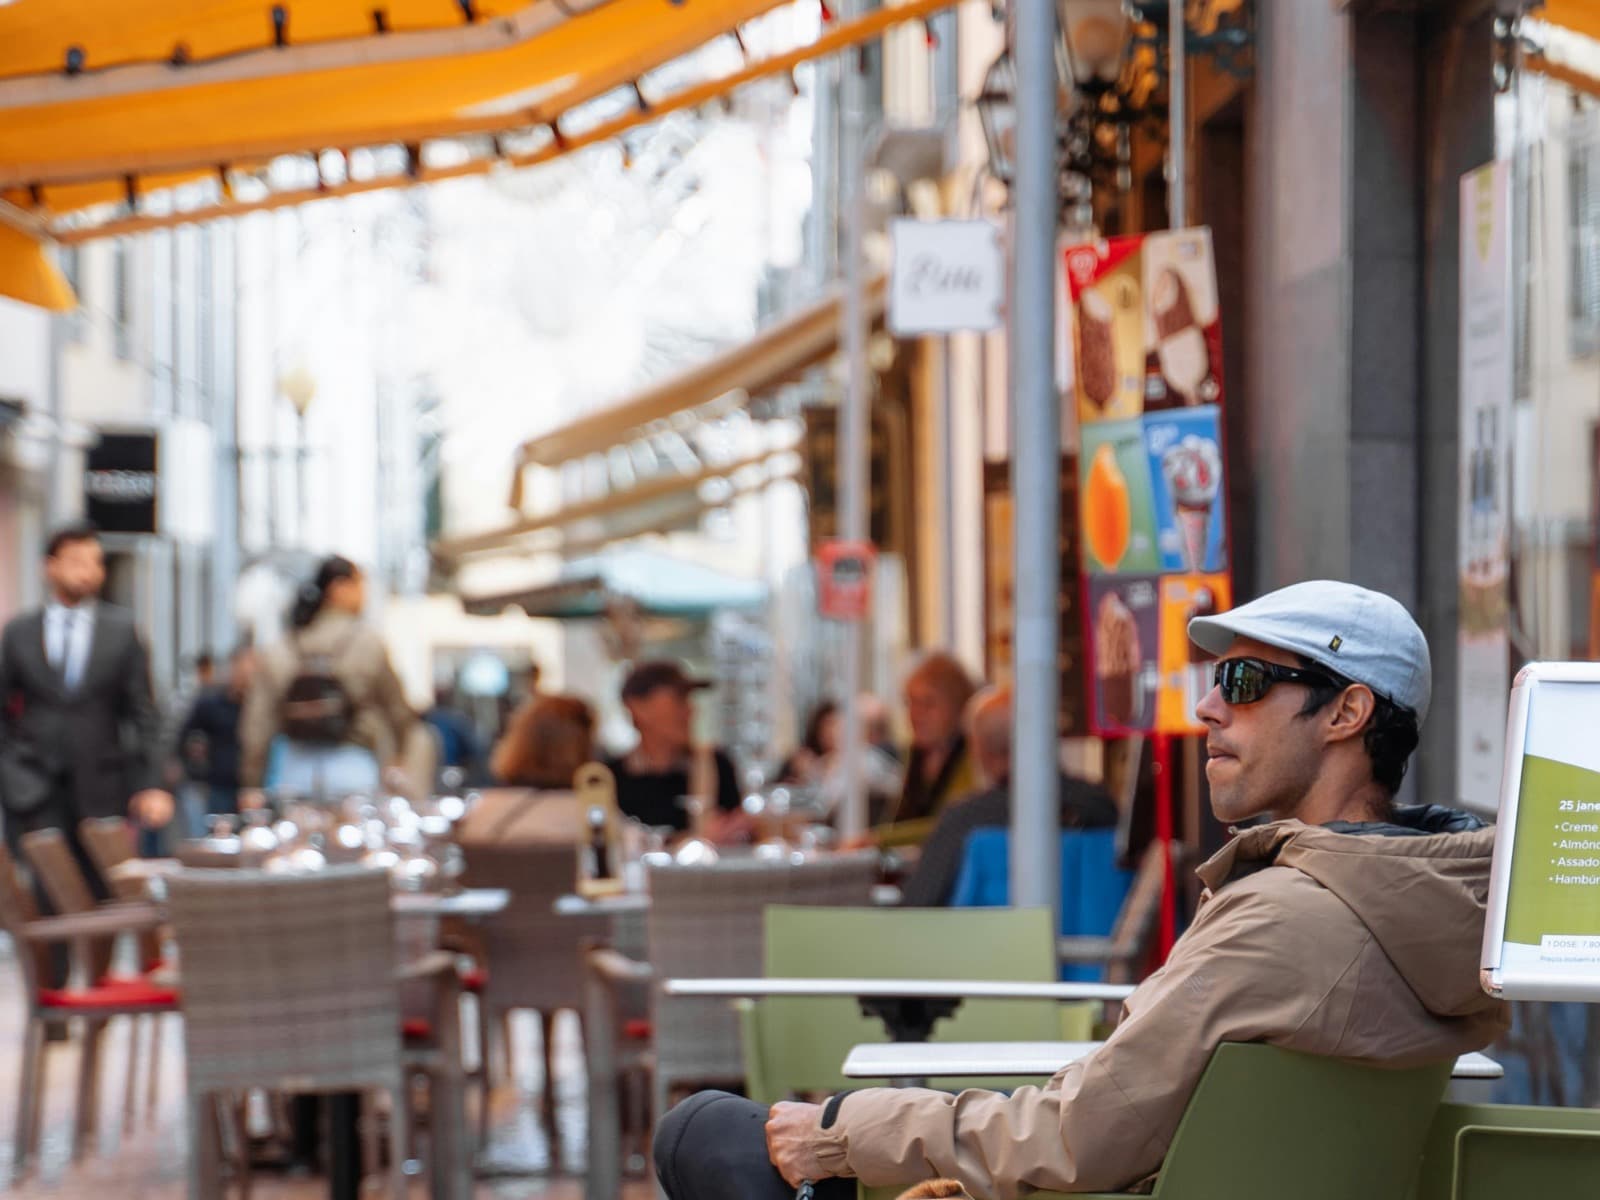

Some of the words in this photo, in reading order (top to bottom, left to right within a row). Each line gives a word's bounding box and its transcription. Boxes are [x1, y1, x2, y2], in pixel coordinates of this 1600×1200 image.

[1559, 799, 1574, 810] 25
[1561, 822, 1599, 832] Creme
[1557, 857, 1600, 867] Assado
